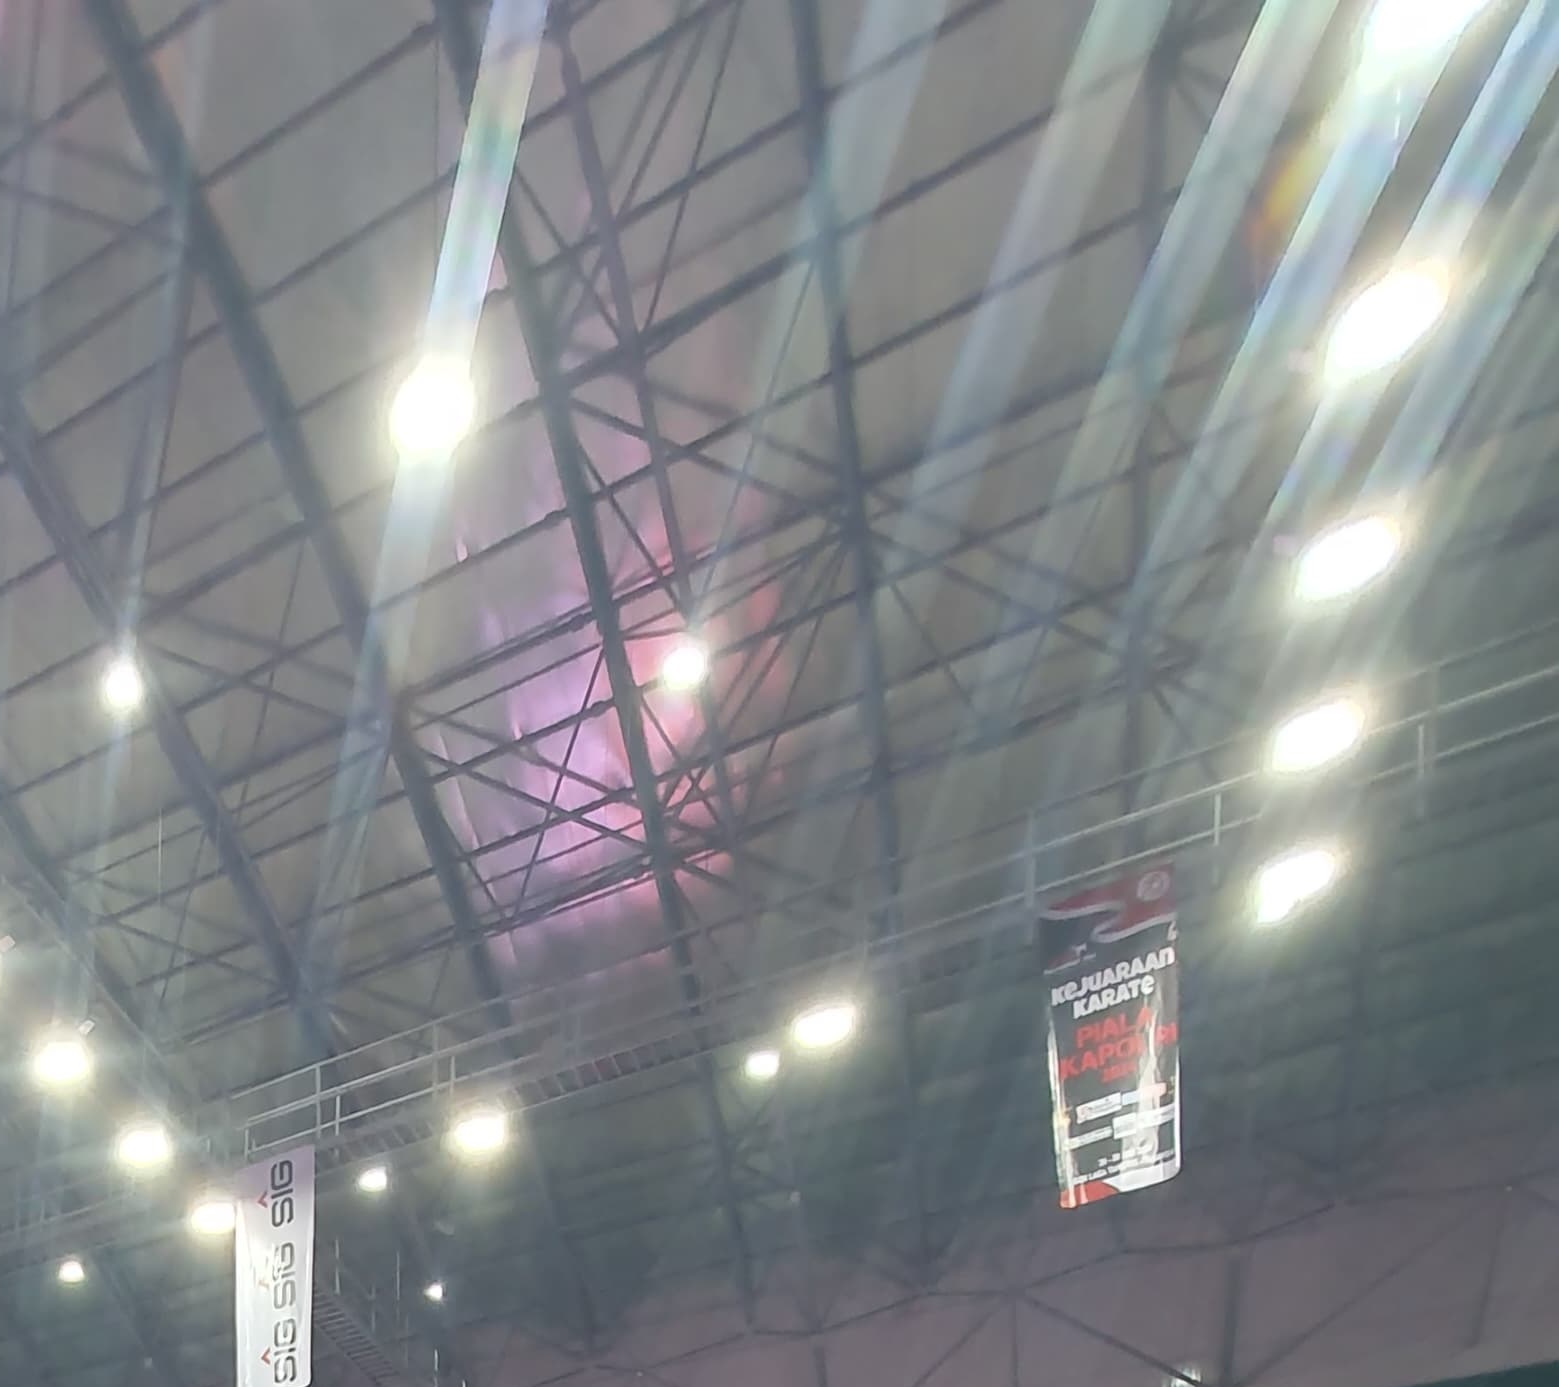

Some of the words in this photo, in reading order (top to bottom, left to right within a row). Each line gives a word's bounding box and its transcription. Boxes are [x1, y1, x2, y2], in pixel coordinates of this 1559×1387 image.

[1059, 1022, 1178, 1081] KAPORI
[1076, 1005, 1152, 1049] PIALA
[270, 1159, 295, 1228] SIG
[272, 1242, 297, 1310] SIG
[274, 1318, 297, 1384] SIG
